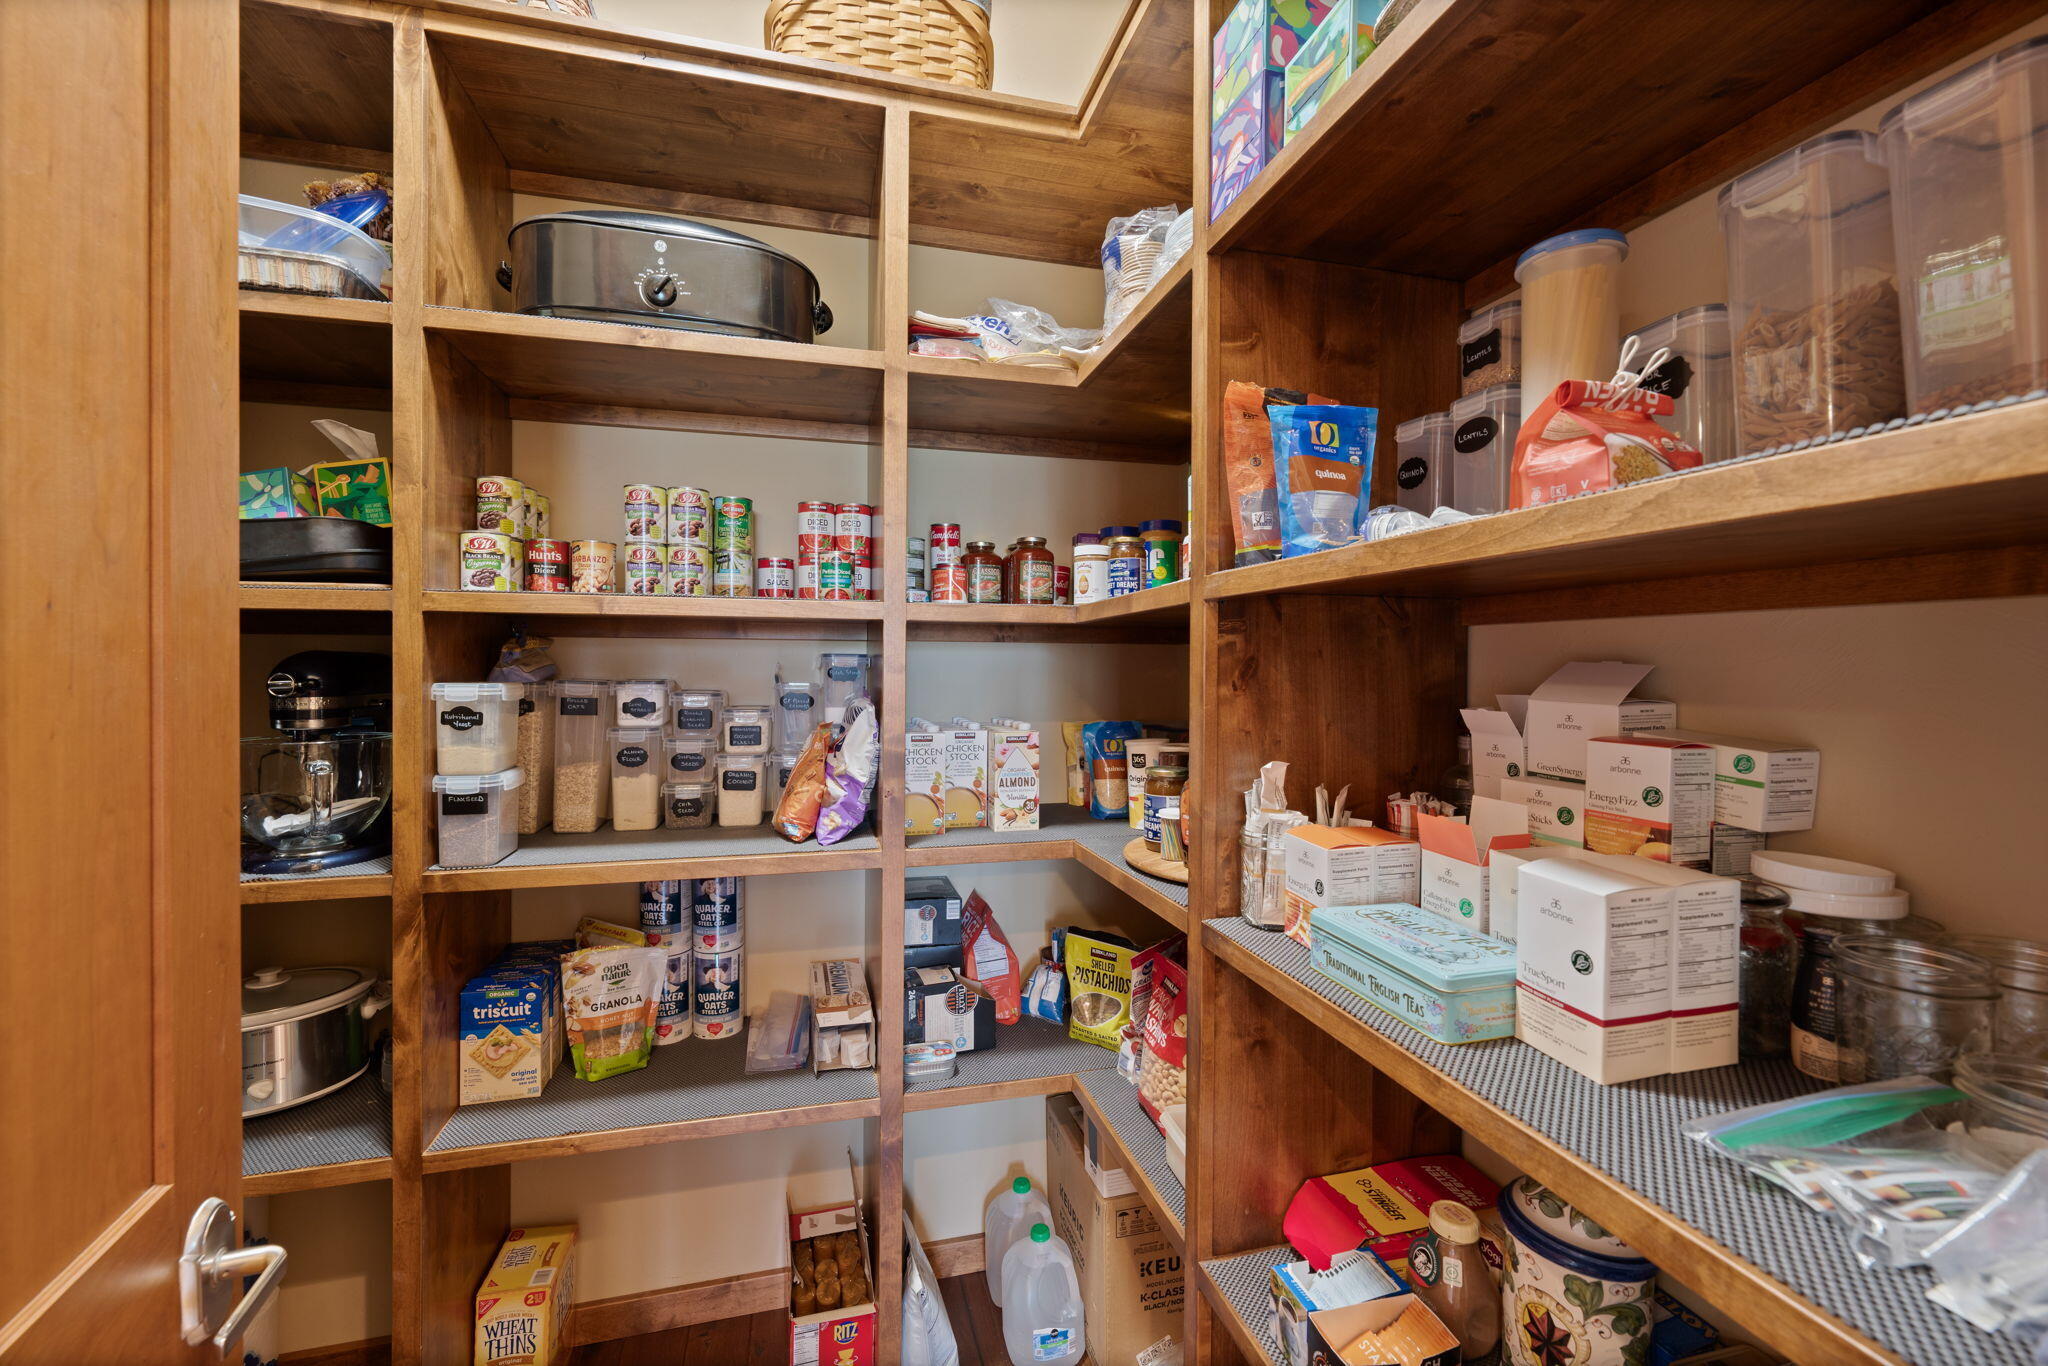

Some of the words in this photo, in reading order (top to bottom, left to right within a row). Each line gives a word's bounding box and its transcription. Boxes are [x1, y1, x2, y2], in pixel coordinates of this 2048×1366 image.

[1457, 428, 1489, 444] LENTILS
[1313, 446, 1337, 454] organics
[1315, 470, 1347, 481] quinoa
[1399, 466, 1425, 480] QUINOA
[807, 519, 829, 527] DICED
[840, 520, 861, 528] DICED
[972, 567, 1000, 575] CLASSICO
[1023, 563, 1052, 571] CLASSICO
[767, 579, 789, 587] SAUCE
[1117, 581, 1138, 589] DREAMS
[945, 744, 985, 753] CHICKEN
[906, 757, 938, 766] STOCK
[950, 753, 980, 761] STOCK
[1132, 755, 1145, 763] 365
[1536, 761, 1584, 777] GreenSynergy
[1609, 764, 1642, 776] arbonne
[999, 777, 1036, 788] ALMOND
[1588, 790, 1639, 807] EnergyFizz
[641, 903, 674, 912] QUAKER
[695, 904, 731, 914] QUAKER
[643, 912, 665, 920] OATS
[700, 913, 722, 921] OATS
[1539, 906, 1574, 925] arbonne
[1493, 930, 1517, 945] TrueS
[1091, 948, 1118, 959] KIRKLAND
[603, 962, 629, 974] open
[1091, 959, 1115, 973] SHELLED
[601, 968, 632, 982] nature
[829, 961, 849, 995] PREMIUM
[1073, 966, 1131, 994] PISTACHIOS
[1522, 960, 1566, 990] TrueSport
[1323, 950, 1366, 986] TRADITIONAL
[1368, 974, 1400, 1006] ENGLISH
[1402, 993, 1425, 1018] TEAS
[659, 991, 684, 1002] AKER
[697, 991, 735, 1002] QUAKER
[908, 989, 916, 1000] 24
[958, 986, 966, 1014] TULLY'S
[590, 994, 643, 1012] GRANOLA
[659, 1001, 676, 1011] ATS
[704, 1001, 727, 1010] OATS
[472, 1001, 532, 1020] triscuit
[600, 1015, 620, 1024] HONEY
[1098, 1033, 1118, 1042] SALTED
[511, 1068, 538, 1077] original
[1363, 1188, 1406, 1221] STINGER
[1140, 1255, 1181, 1278] KEU
[527, 1294, 535, 1304] 2
[1140, 1286, 1184, 1303] K-CLASS
[483, 1318, 538, 1340] WHEAT
[834, 1321, 859, 1342] RITZ
[1359, 1340, 1388, 1366] STA
